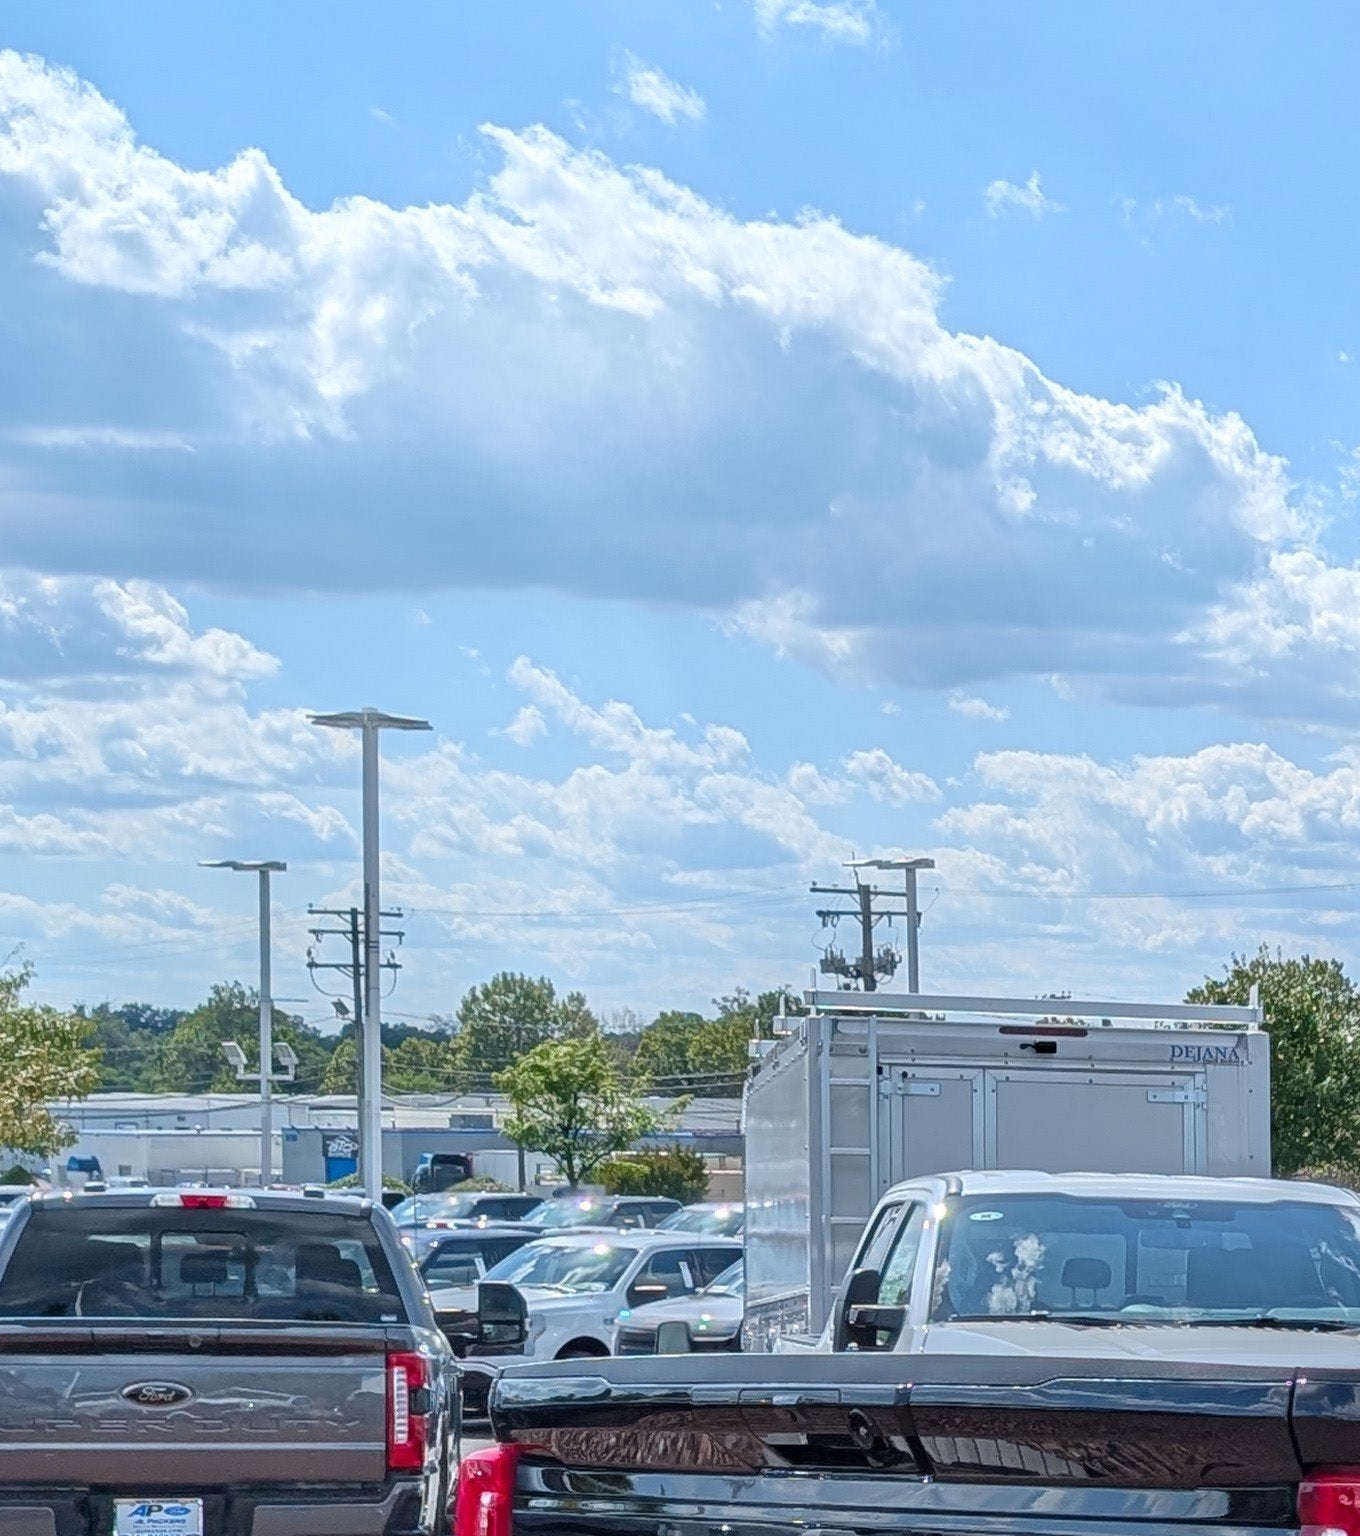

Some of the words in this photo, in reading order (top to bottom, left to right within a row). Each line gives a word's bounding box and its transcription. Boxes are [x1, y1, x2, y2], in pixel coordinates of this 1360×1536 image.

[1169, 1045, 1240, 1062] DEJANA
[139, 1386, 176, 1402] Ford
[194, 1418, 362, 1434] DUTY
[127, 1504, 163, 1518] AP
